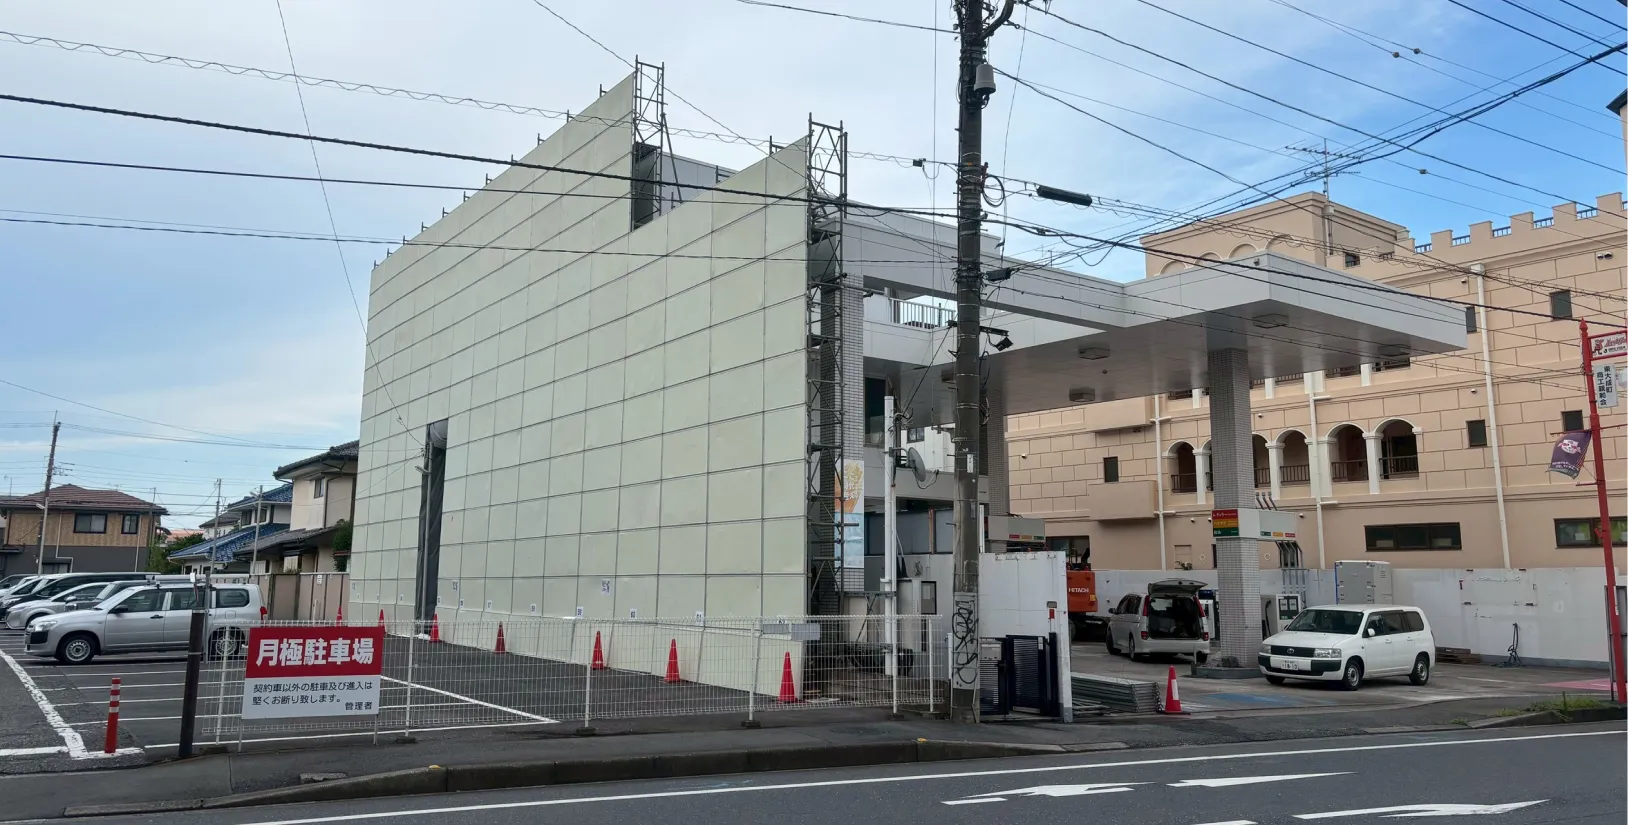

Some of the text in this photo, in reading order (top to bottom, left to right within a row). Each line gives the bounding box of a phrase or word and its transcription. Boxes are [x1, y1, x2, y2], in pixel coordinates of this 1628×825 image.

[256, 638, 374, 666] 月極駐車場
[253, 682, 373, 693] 契約車以外の駐車及び進入は
[252, 694, 341, 705] 堅くお断り致します。
[345, 702, 372, 710] 管理者
